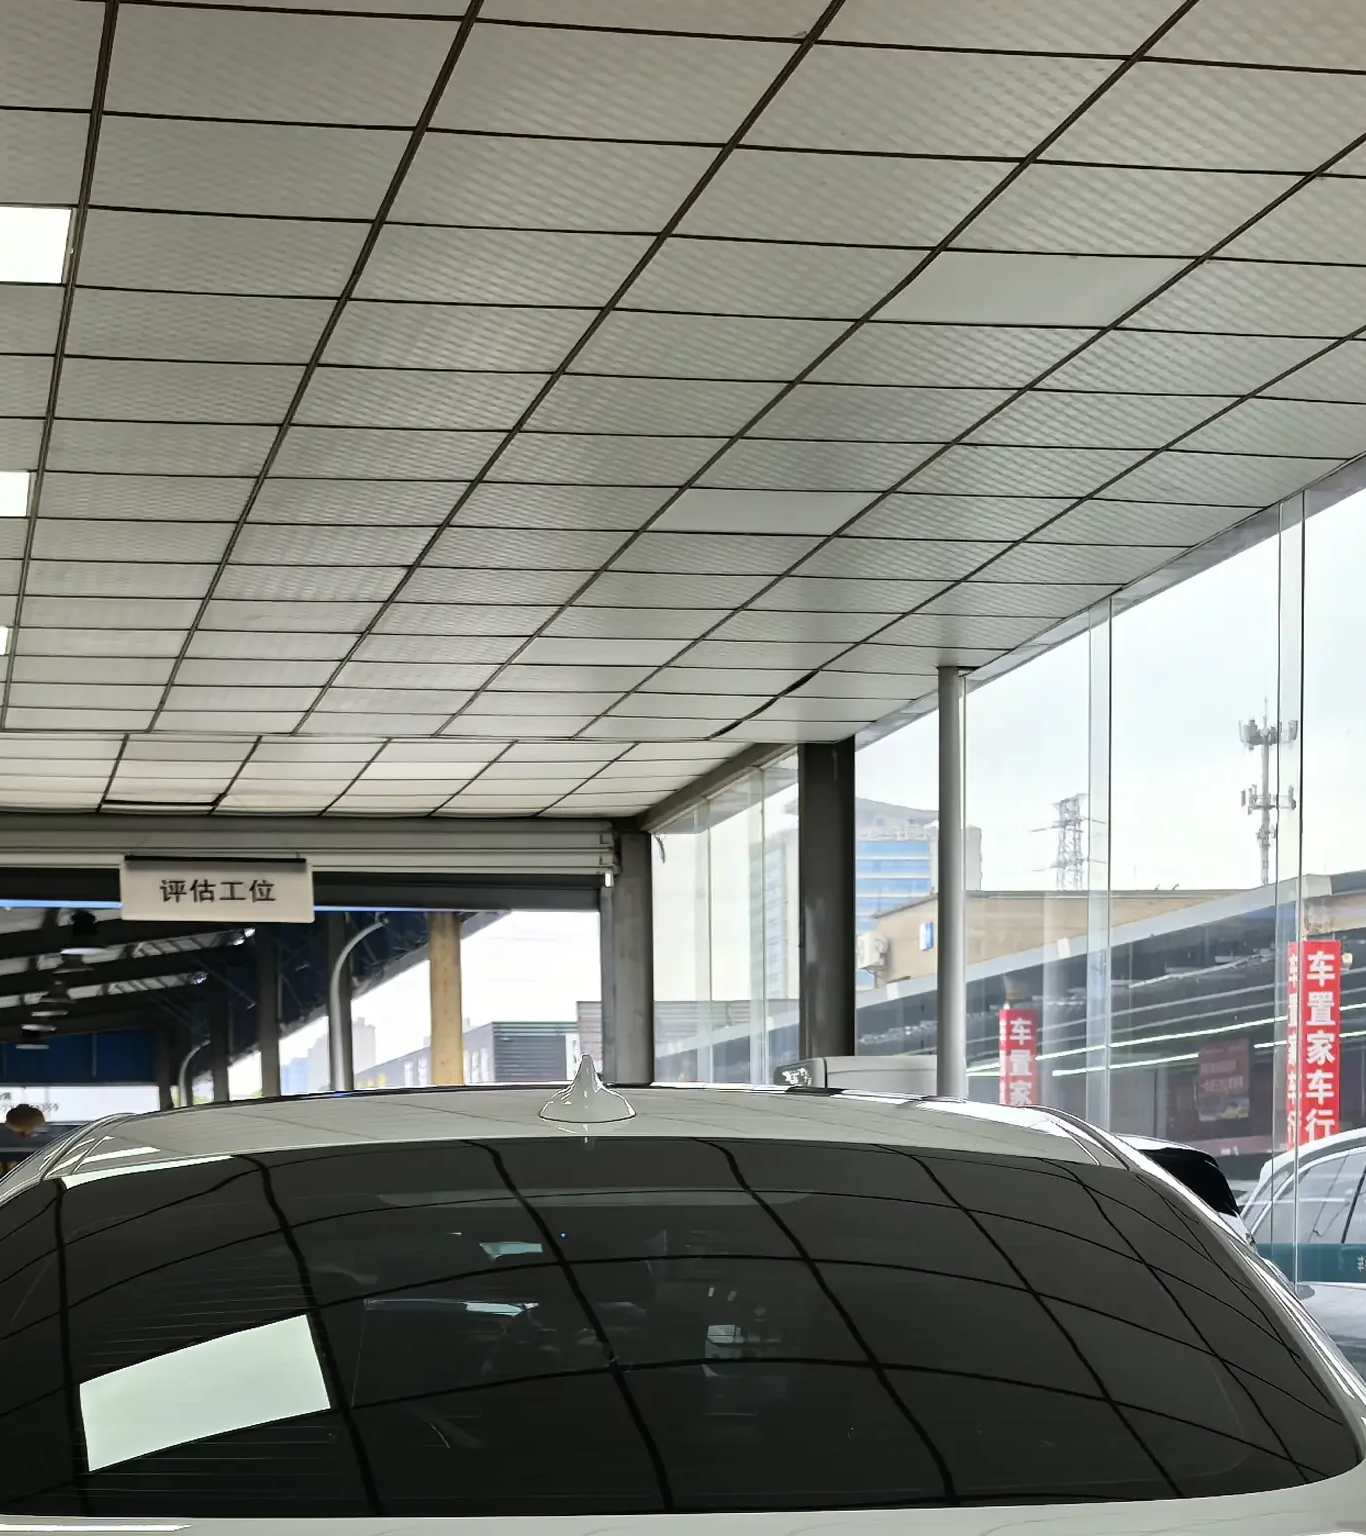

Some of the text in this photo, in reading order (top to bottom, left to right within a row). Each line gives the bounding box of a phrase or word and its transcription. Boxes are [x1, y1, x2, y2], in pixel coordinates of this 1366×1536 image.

[160, 879, 276, 903] 评估工位
[1305, 951, 1336, 1146] 车置家车行
